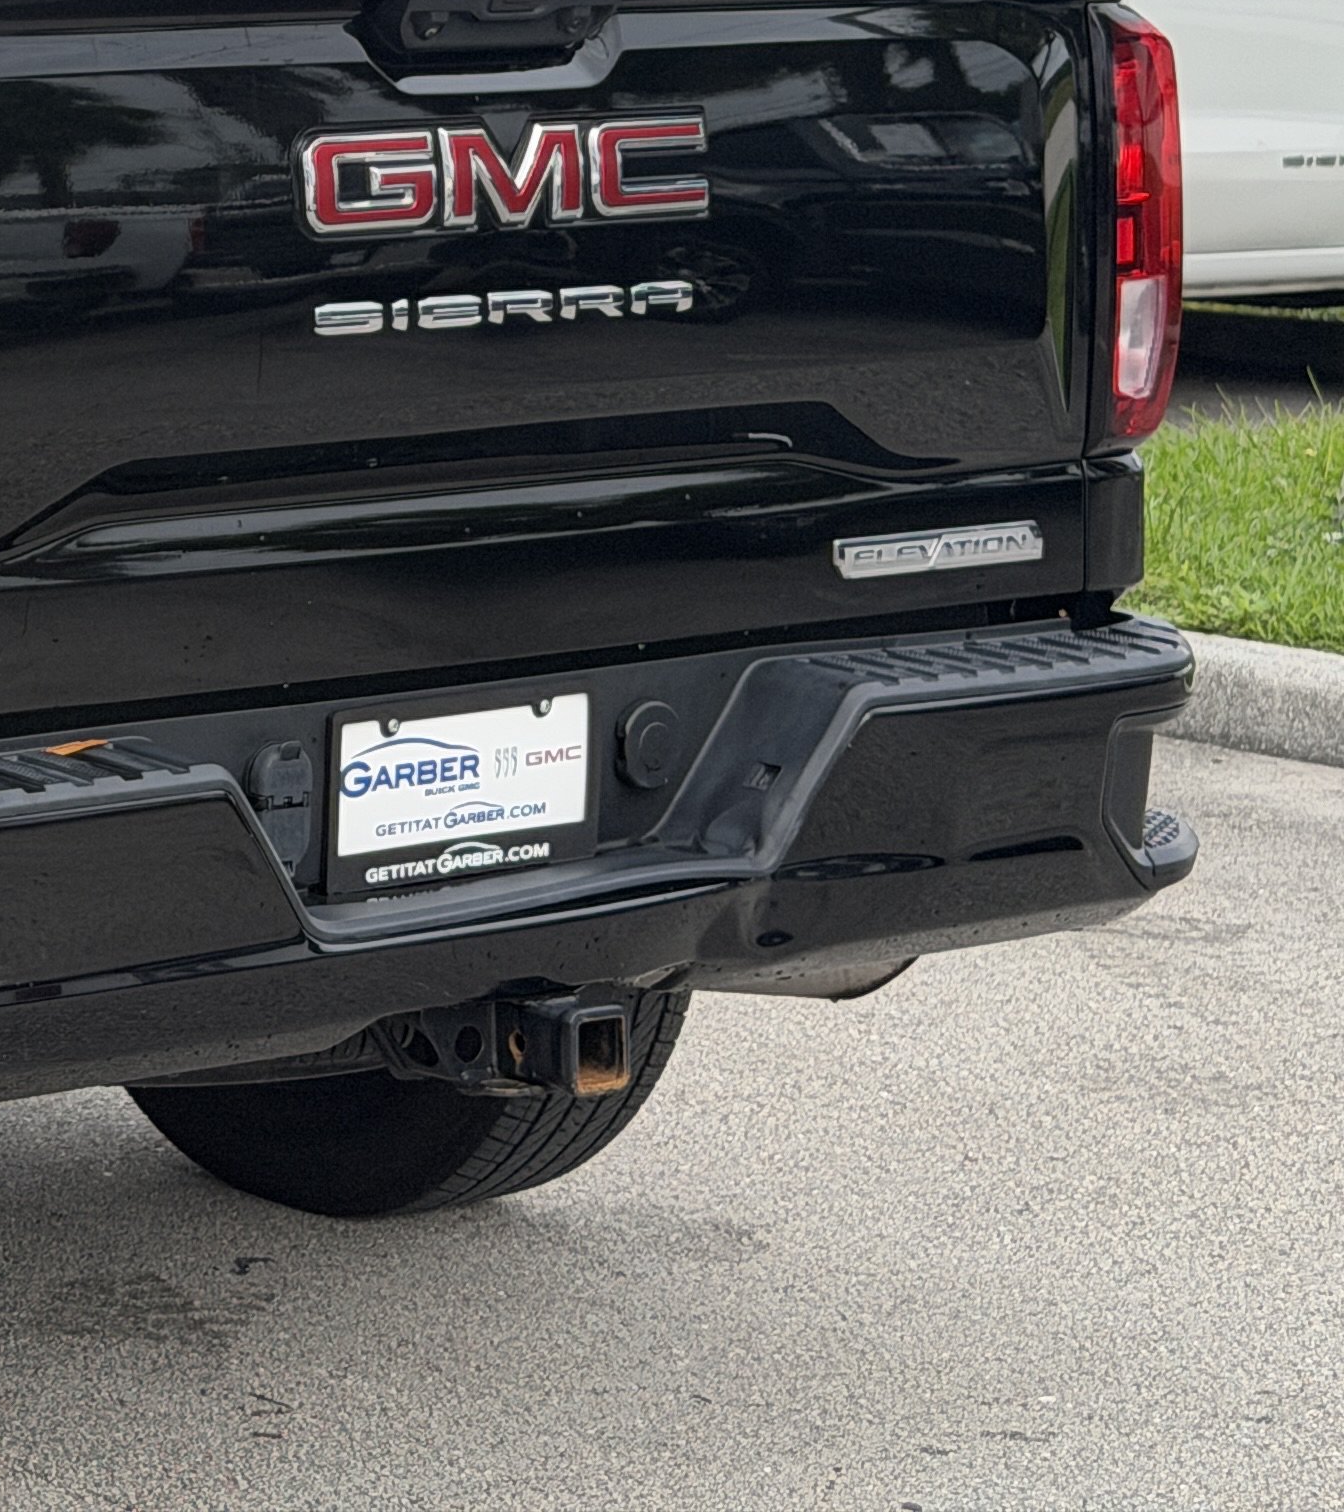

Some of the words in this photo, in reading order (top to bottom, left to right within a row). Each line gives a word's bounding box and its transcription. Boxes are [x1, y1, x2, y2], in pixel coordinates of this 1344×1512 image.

[301, 116, 710, 233] GMC
[313, 280, 694, 337] SIERRA
[340, 753, 480, 798] GARBER
[524, 744, 583, 767] GMC
[375, 802, 547, 837] GETITATGARBER.COM
[365, 842, 550, 884] GETITATGARBER.COM
